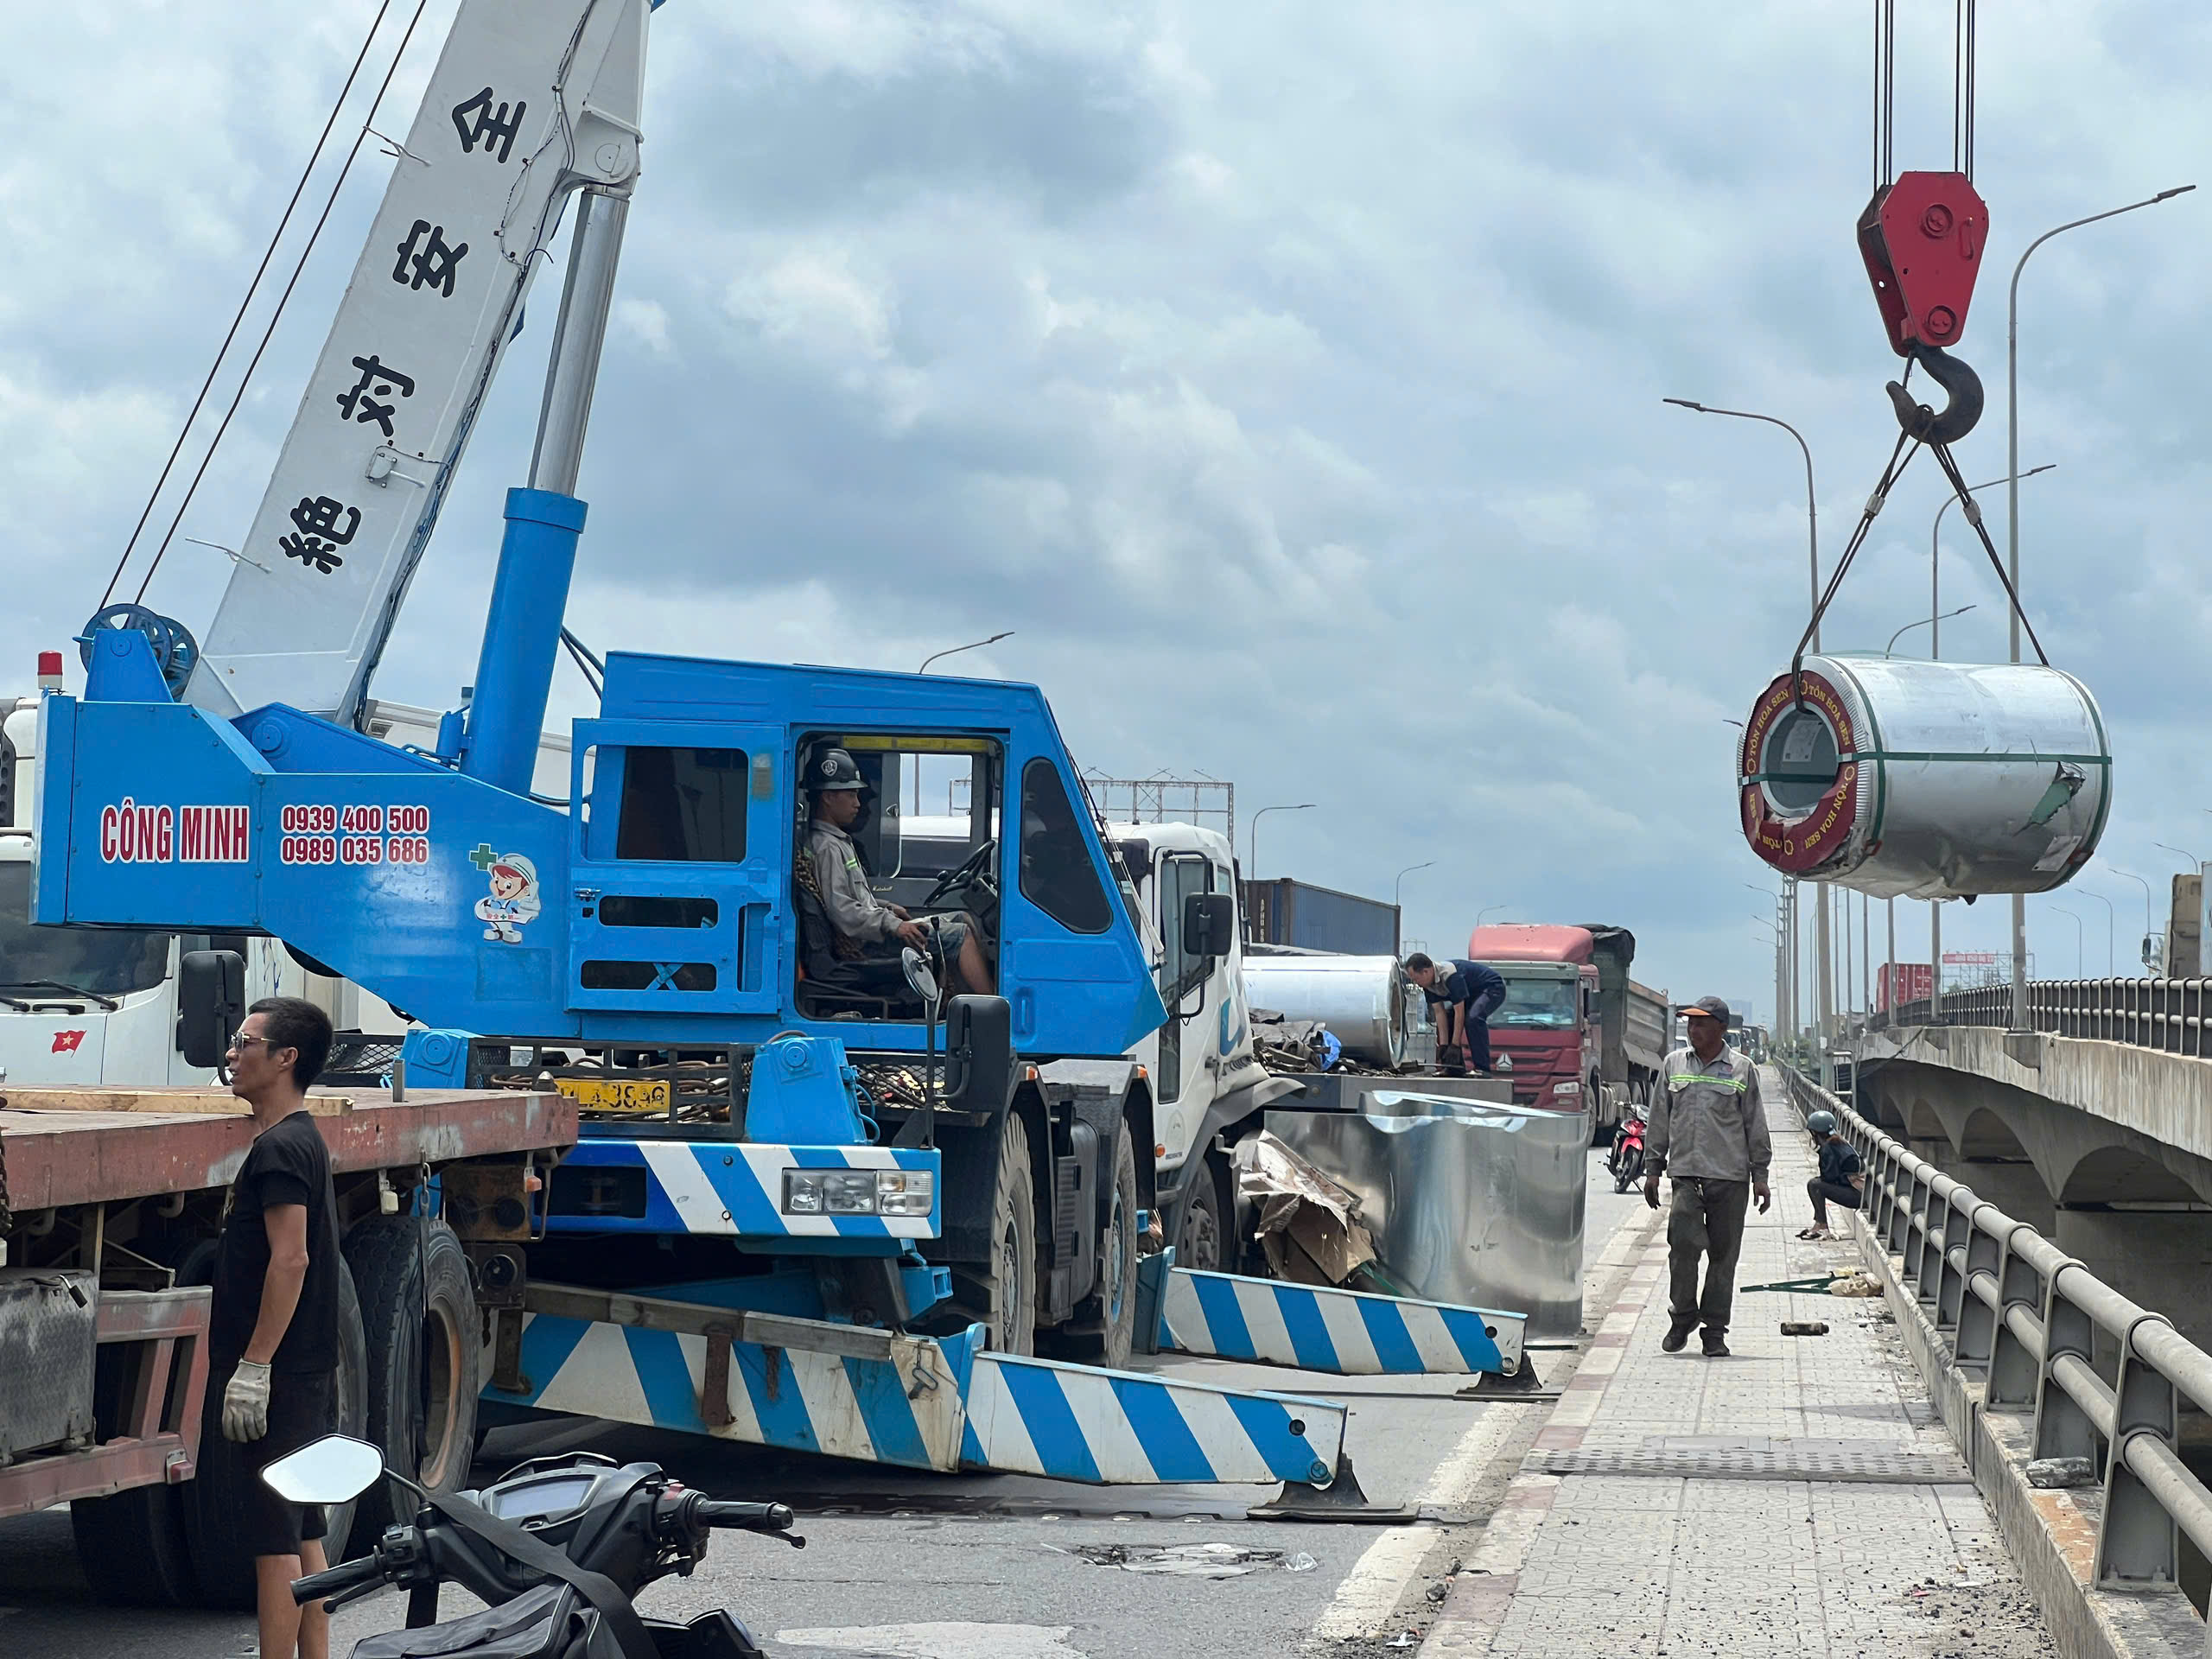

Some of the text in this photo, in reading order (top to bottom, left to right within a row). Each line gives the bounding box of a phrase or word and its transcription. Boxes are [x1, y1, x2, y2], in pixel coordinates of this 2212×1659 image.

[1770, 689, 1789, 707] SEN
[1809, 685, 1826, 702] TÔN
[1826, 698, 1840, 721] HOA
[101, 798, 249, 862] CÔNG MINH
[283, 807, 429, 832] 0939 400 500
[1820, 810, 1837, 834] HOA
[282, 837, 429, 862] 0989 035 686
[1804, 831, 1821, 849] SEN
